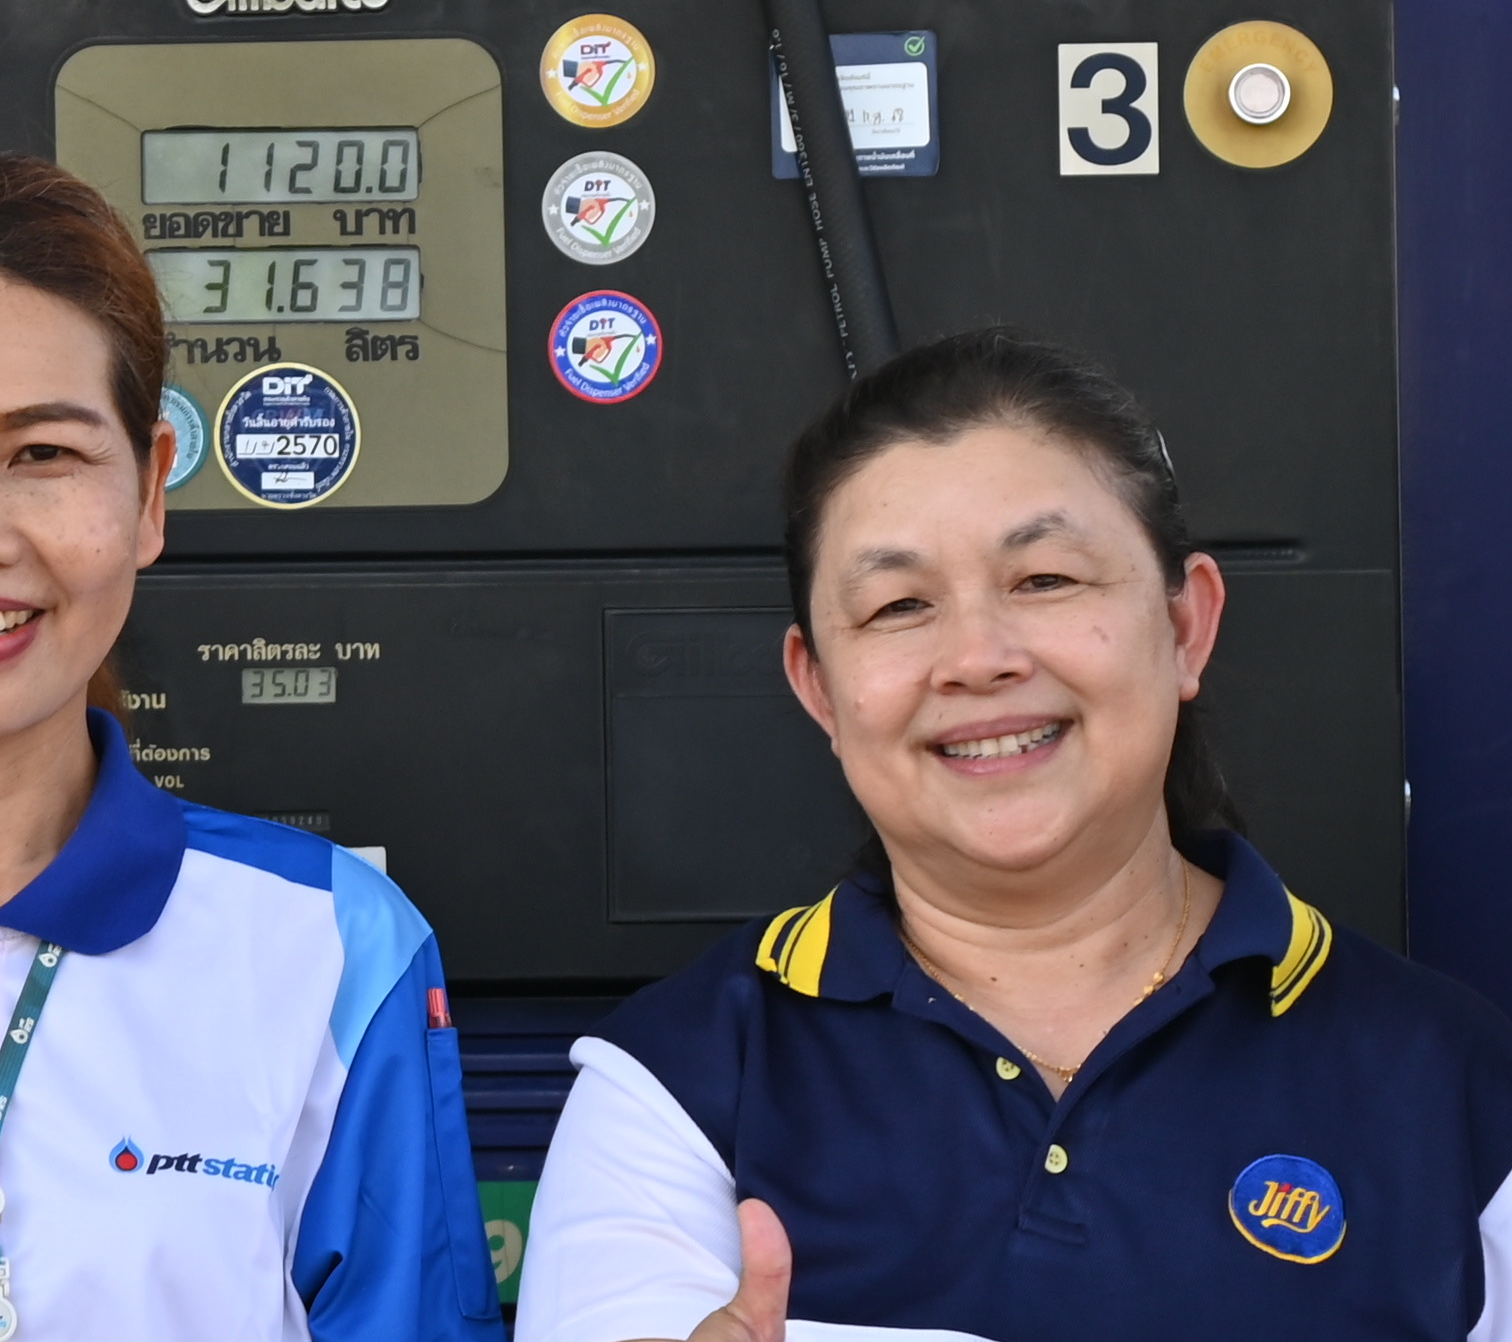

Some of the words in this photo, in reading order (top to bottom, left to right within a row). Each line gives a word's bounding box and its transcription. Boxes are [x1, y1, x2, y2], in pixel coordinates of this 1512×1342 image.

[1199, 29, 1319, 72] EMERGENCY
[1066, 51, 1152, 167] 3
[218, 139, 409, 196] 1120.0
[141, 208, 291, 239] ยอดขาย
[333, 207, 416, 237] บาท
[806, 191, 825, 230] HOSE
[818, 236, 836, 277] PUMP
[203, 258, 410, 314] 31.638
[167, 331, 281, 365] ำนวน
[344, 327, 420, 362] ลิตร
[564, 368, 583, 387] Fuel
[276, 435, 338, 456] 2570
[197, 637, 321, 662] ราคาลิตรละ
[334, 641, 381, 660] บาท
[251, 669, 333, 698] 35.03
[154, 775, 185, 789] VOL
[1248, 1180, 1330, 1233] Jiffy
